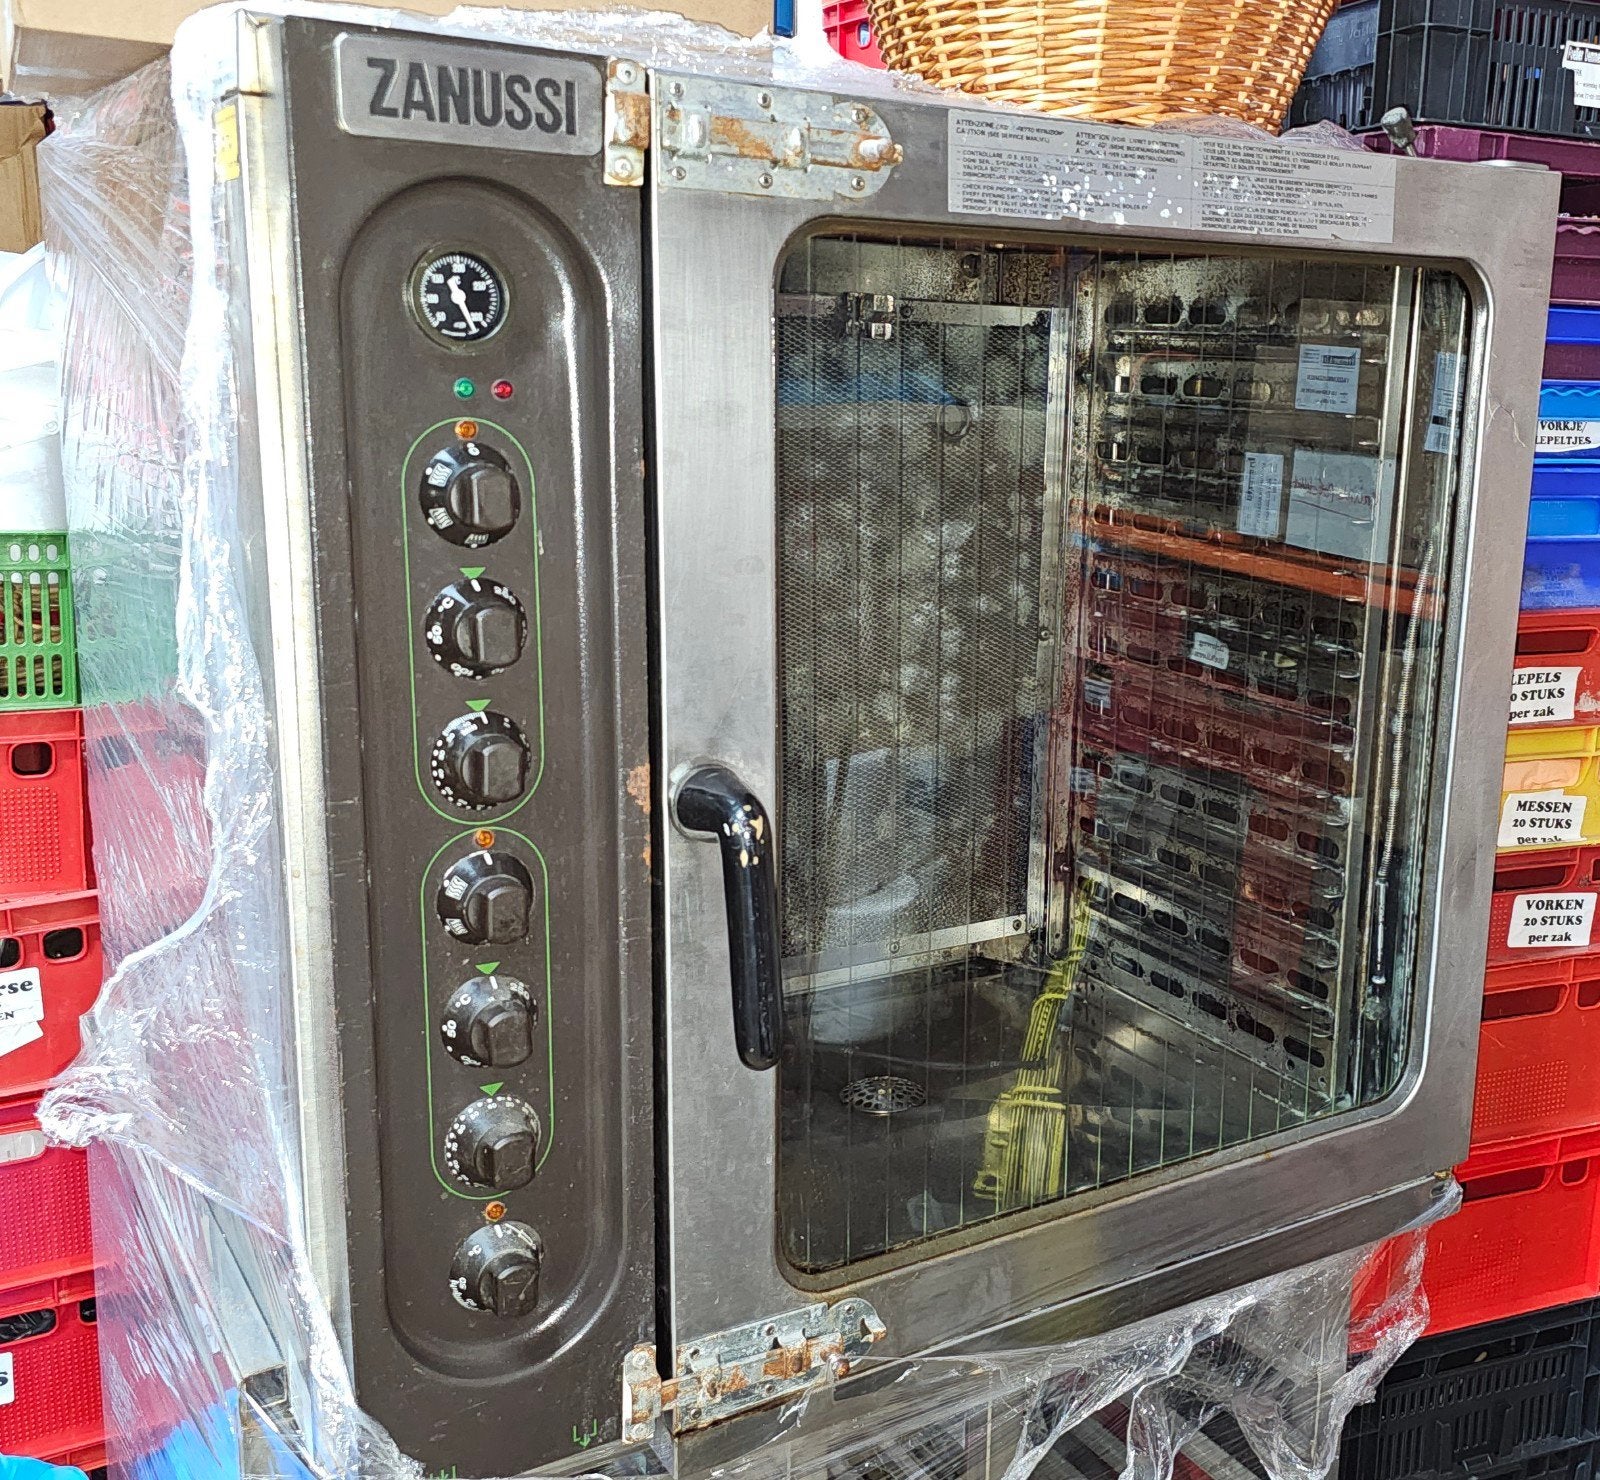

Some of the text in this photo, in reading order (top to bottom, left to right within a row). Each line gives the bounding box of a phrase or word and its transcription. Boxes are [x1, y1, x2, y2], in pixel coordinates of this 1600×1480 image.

[367, 57, 577, 136] ZANUSSI
[1521, 688, 1565, 701] STUKS
[1508, 706, 1554, 721] per zak
[1516, 801, 1572, 813] MESSEN
[1512, 818, 1572, 829] 20 STUKS
[1526, 899, 1584, 910] VORKEN
[1524, 916, 1583, 926] 20 STUKS
[1528, 932, 1572, 944] per zak
